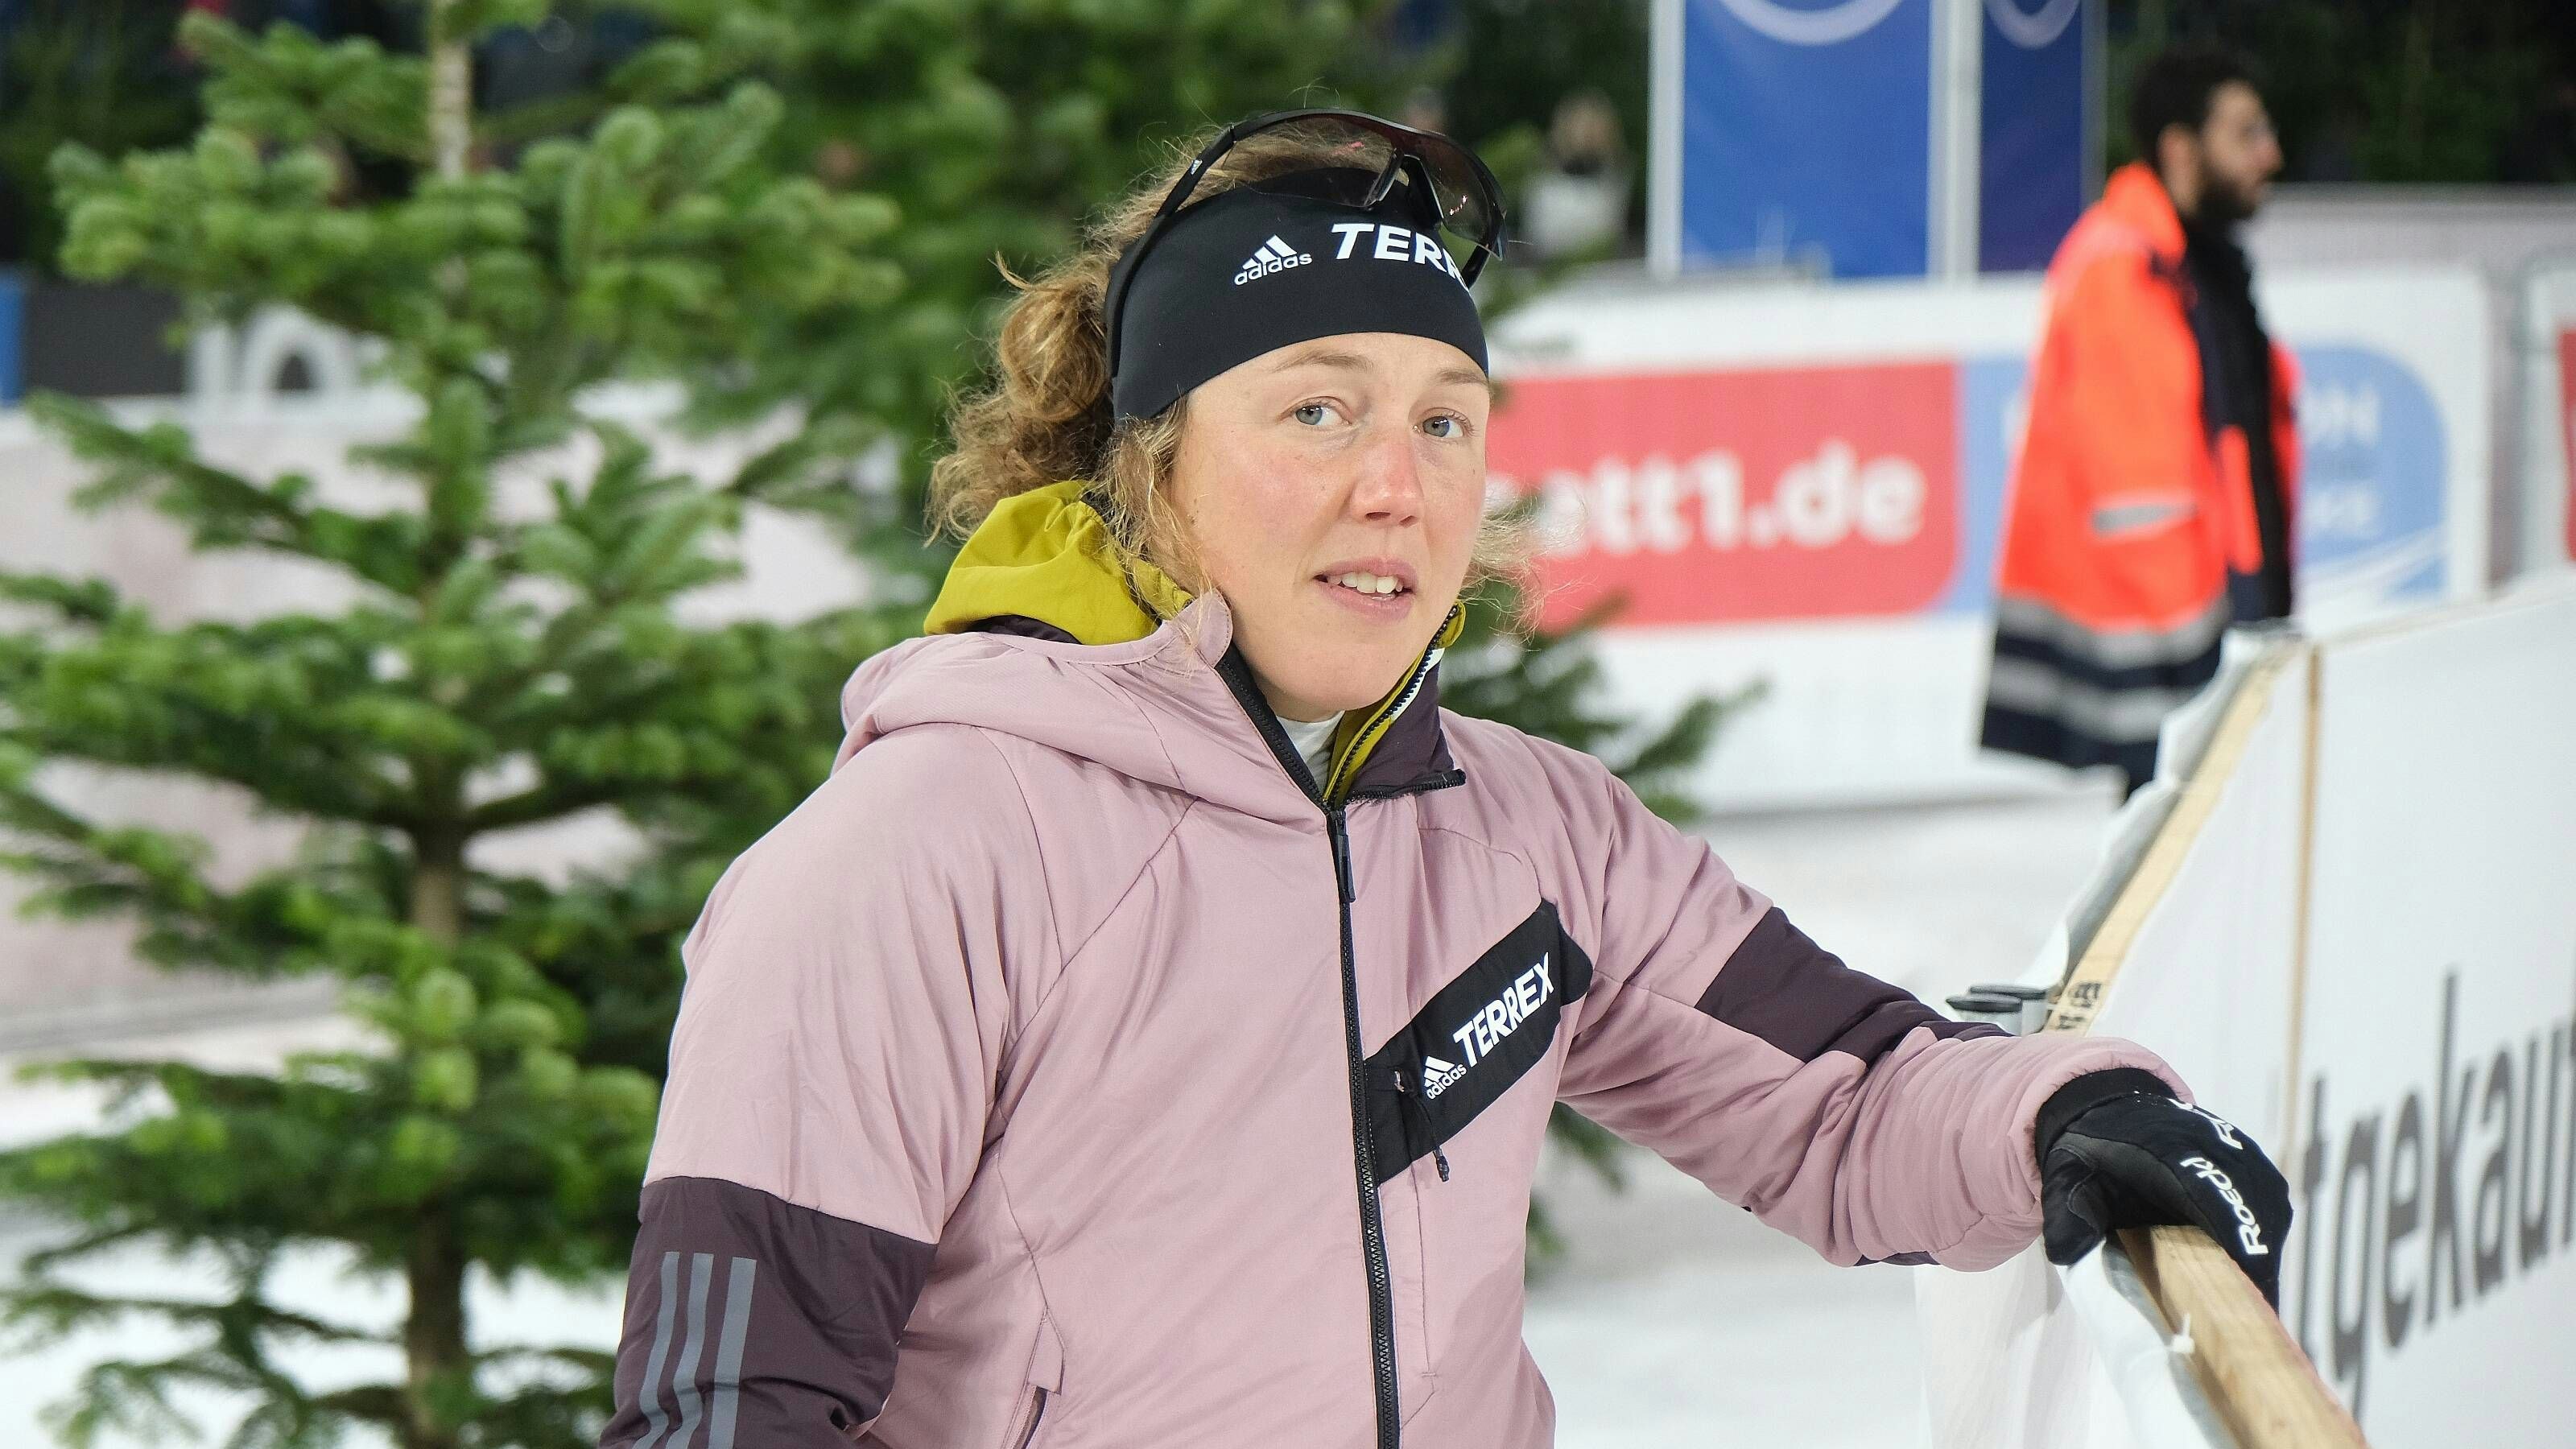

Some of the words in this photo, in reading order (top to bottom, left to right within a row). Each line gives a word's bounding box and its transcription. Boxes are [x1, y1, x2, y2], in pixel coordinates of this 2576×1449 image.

[1233, 252, 1313, 286] adidas
[1426, 1063, 1468, 1100] adidas
[1452, 952, 1554, 1068] TERREX
